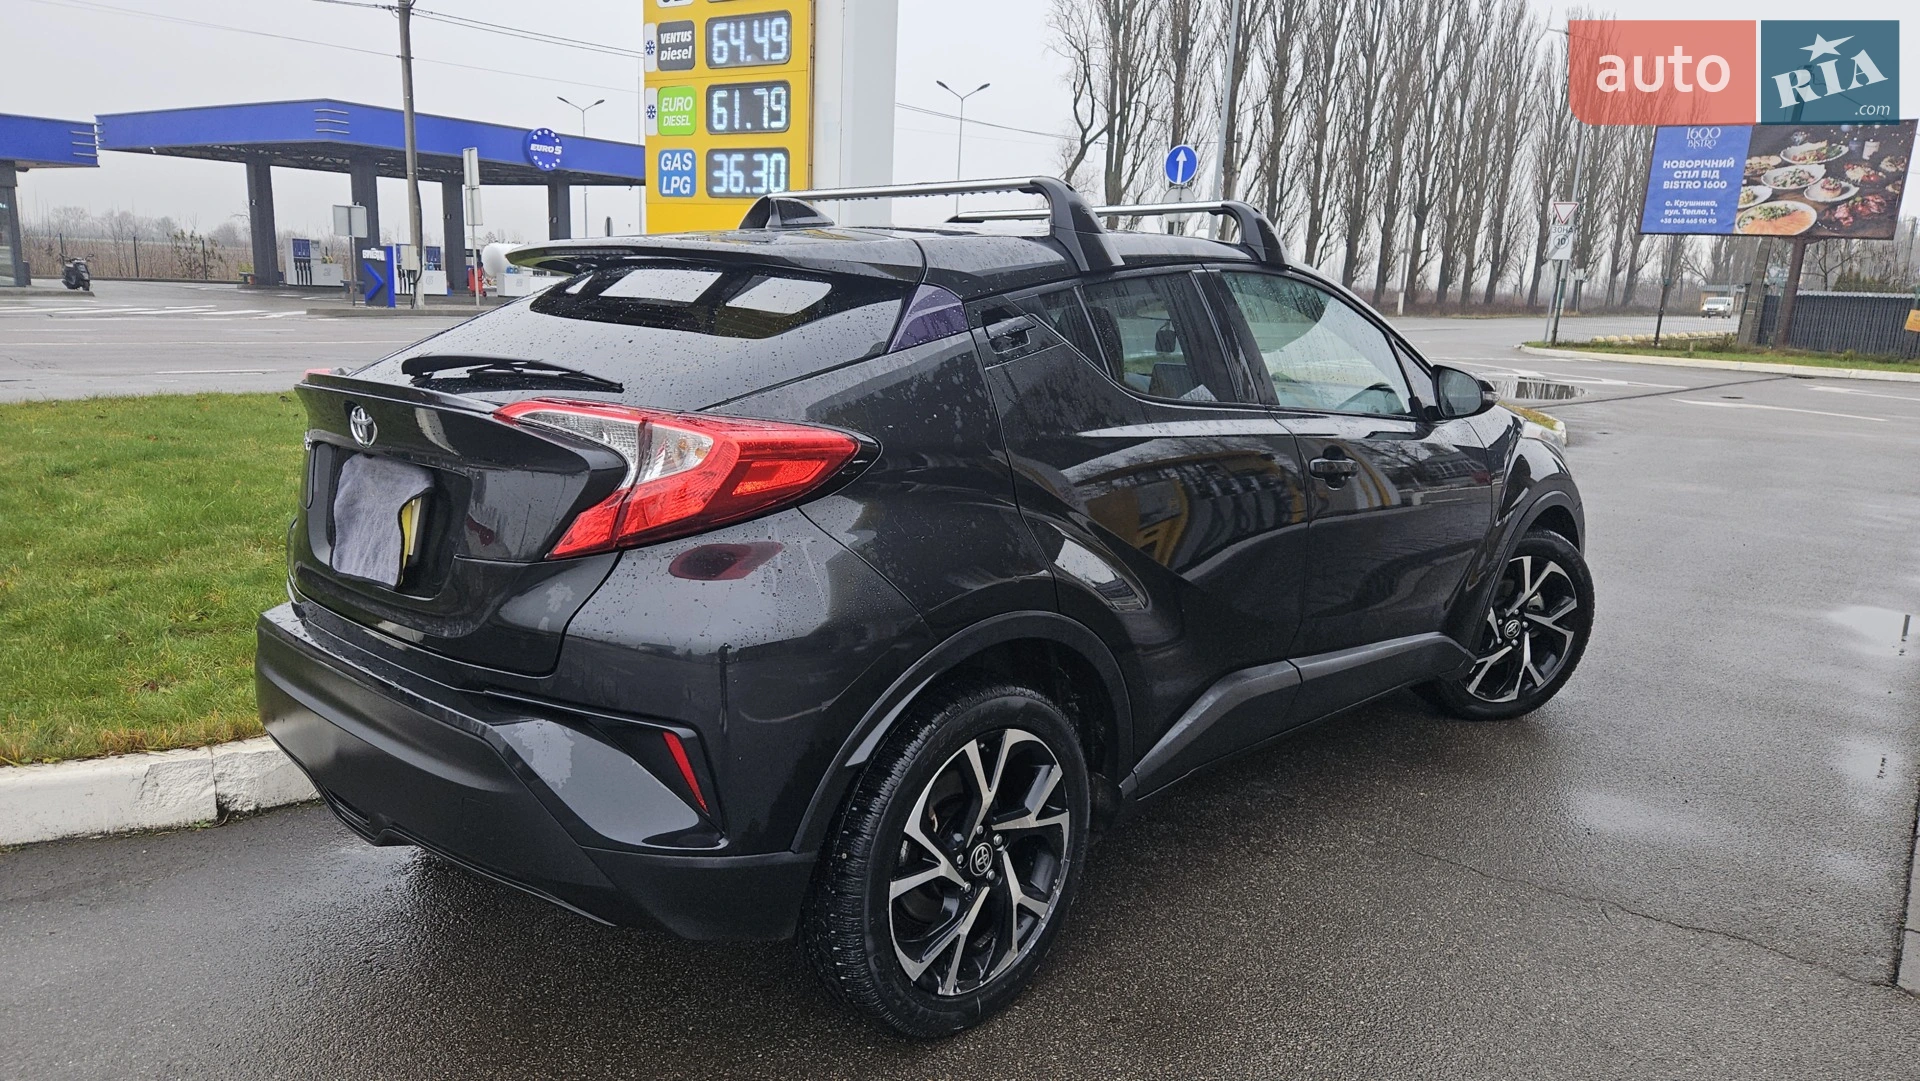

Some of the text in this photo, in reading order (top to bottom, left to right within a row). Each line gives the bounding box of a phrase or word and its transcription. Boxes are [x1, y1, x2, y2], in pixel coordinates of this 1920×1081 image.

[660, 30, 692, 44] VENTUS
[712, 17, 788, 64] 64.49
[660, 45, 692, 61] Diesel
[661, 96, 693, 112] EURO
[712, 86, 787, 130] 61.79
[663, 115, 691, 127] DIESEL
[1686, 127, 1721, 139] 1600
[1687, 138, 1717, 149] BISTRO
[660, 152, 692, 171] GAS
[1663, 158, 1735, 168] НОВОРІЧНИЙ
[713, 153, 786, 194] 36.30
[1673, 170, 1720, 179] СТІЛ ВІД
[662, 176, 691, 195] LPG
[1663, 180, 1728, 189] BISTRO 1600
